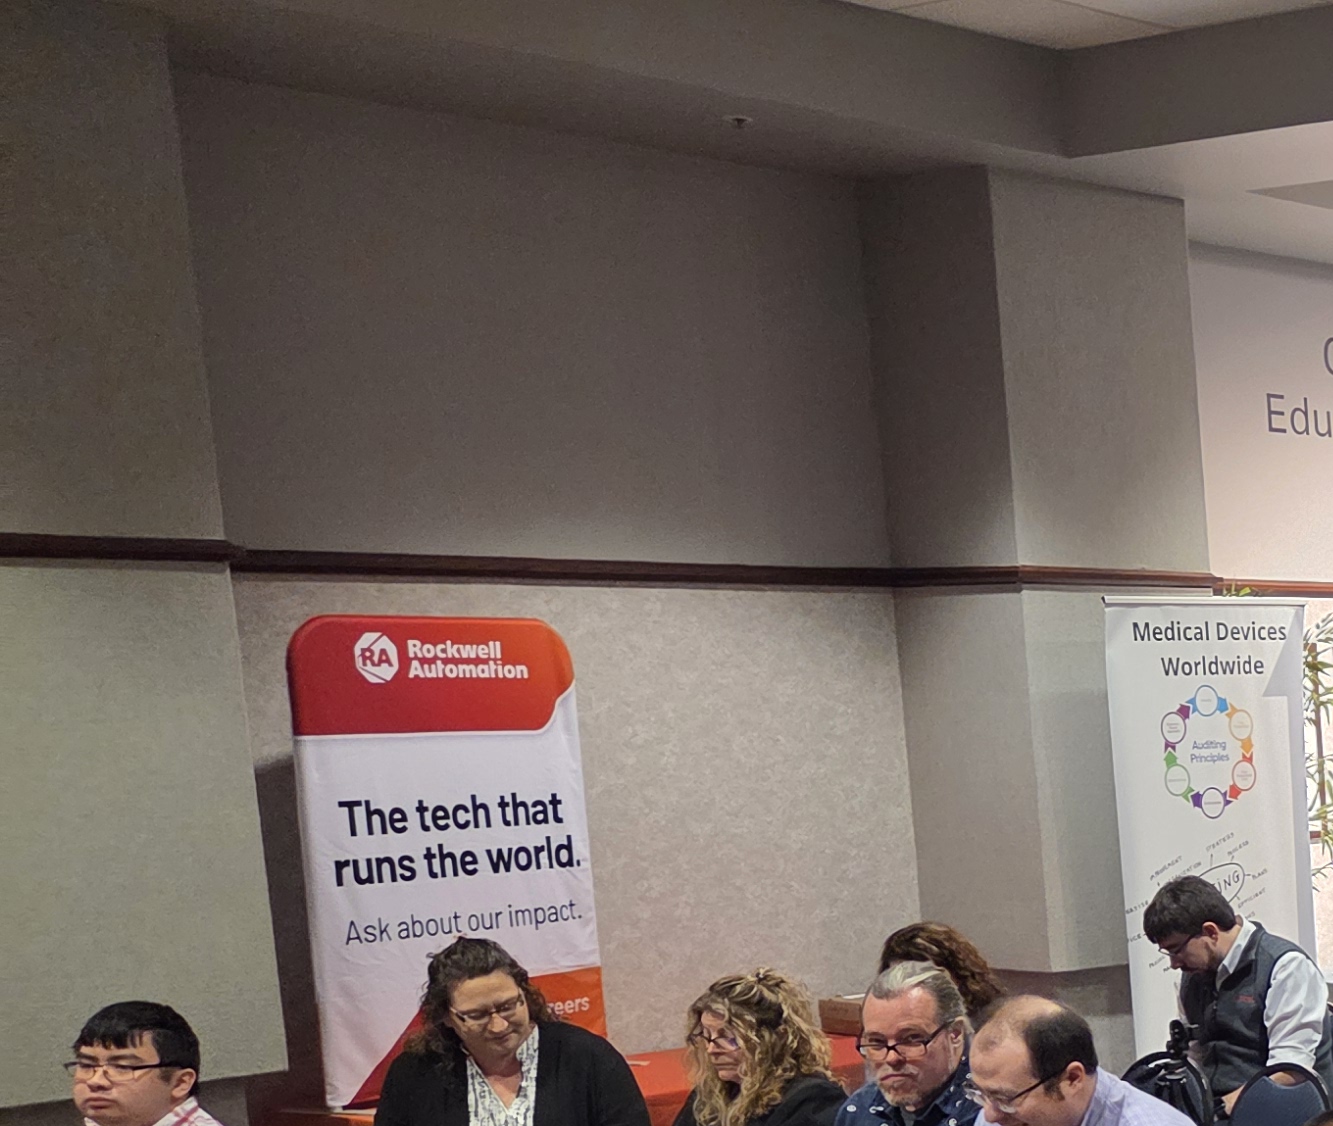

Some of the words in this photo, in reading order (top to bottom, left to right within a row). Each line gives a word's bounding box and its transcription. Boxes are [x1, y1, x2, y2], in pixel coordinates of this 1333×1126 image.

[1132, 620, 1210, 643] Medical
[1216, 621, 1287, 642] Devices
[360, 648, 394, 667] RA
[407, 639, 502, 659] Rockwell
[408, 660, 529, 679] Automation
[1161, 654, 1265, 677] Worldwide
[1192, 740, 1227, 751] Auditing
[1190, 753, 1230, 764] Principles
[338, 800, 408, 837] The
[416, 794, 492, 832] tech
[498, 792, 564, 827] that
[334, 854, 417, 887] runs
[423, 843, 479, 879] the
[486, 834, 581, 874] world.
[345, 917, 392, 946] Ask
[397, 911, 462, 940] about
[467, 912, 503, 932] our
[508, 899, 582, 931] impact.
[547, 996, 590, 1015] reers
